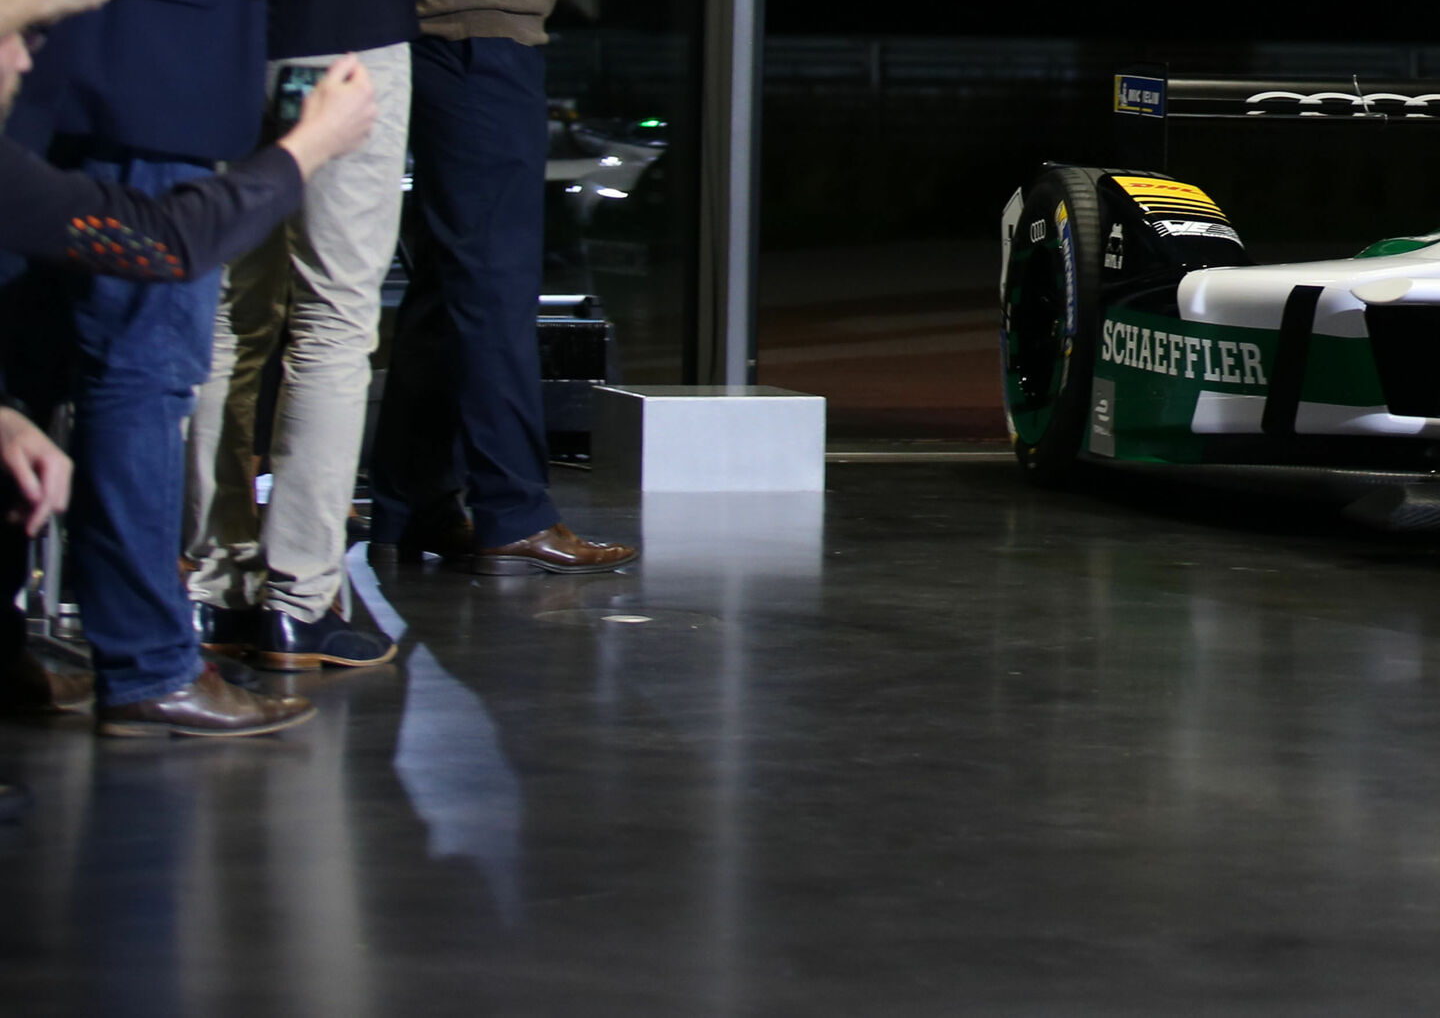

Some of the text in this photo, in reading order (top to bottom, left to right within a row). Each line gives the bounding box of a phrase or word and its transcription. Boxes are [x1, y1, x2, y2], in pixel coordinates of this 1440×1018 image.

[1128, 89, 1160, 105] MICELIN
[1129, 182, 1198, 194] DHL
[1102, 318, 1267, 386] SCHAEFFLER
